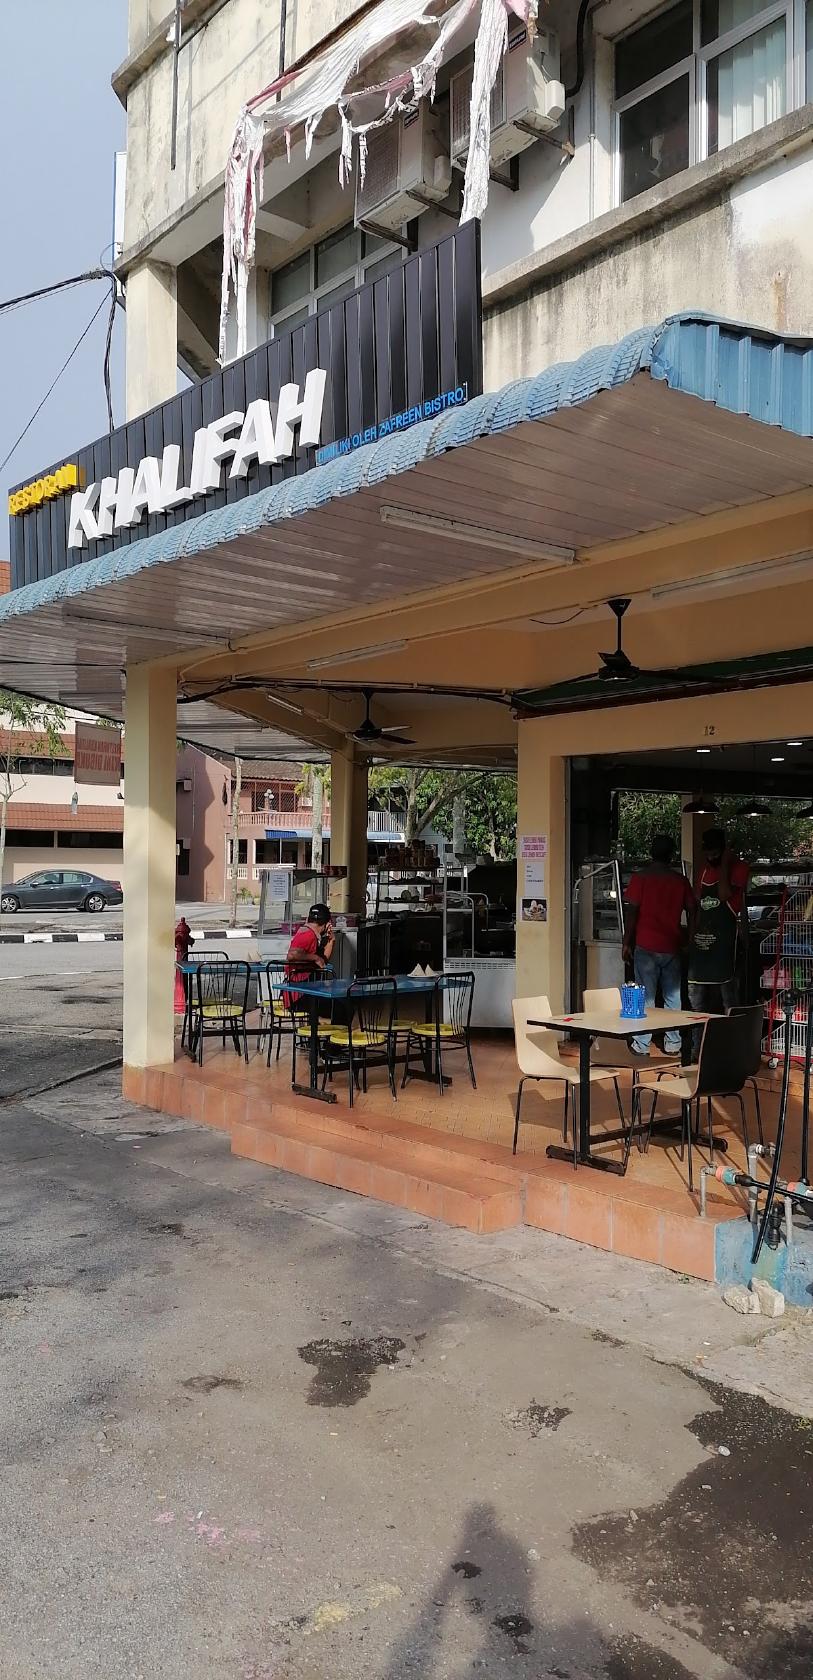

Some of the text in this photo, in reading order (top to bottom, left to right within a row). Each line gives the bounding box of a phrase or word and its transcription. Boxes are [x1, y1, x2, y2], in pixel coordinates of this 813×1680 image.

[352, 425, 377, 447] OLEH
[378, 404, 422, 437] ZAFREEN
[424, 387, 464, 416] BISTRO
[67, 368, 326, 549] KHALIFAH
[704, 725, 716, 737] 12
